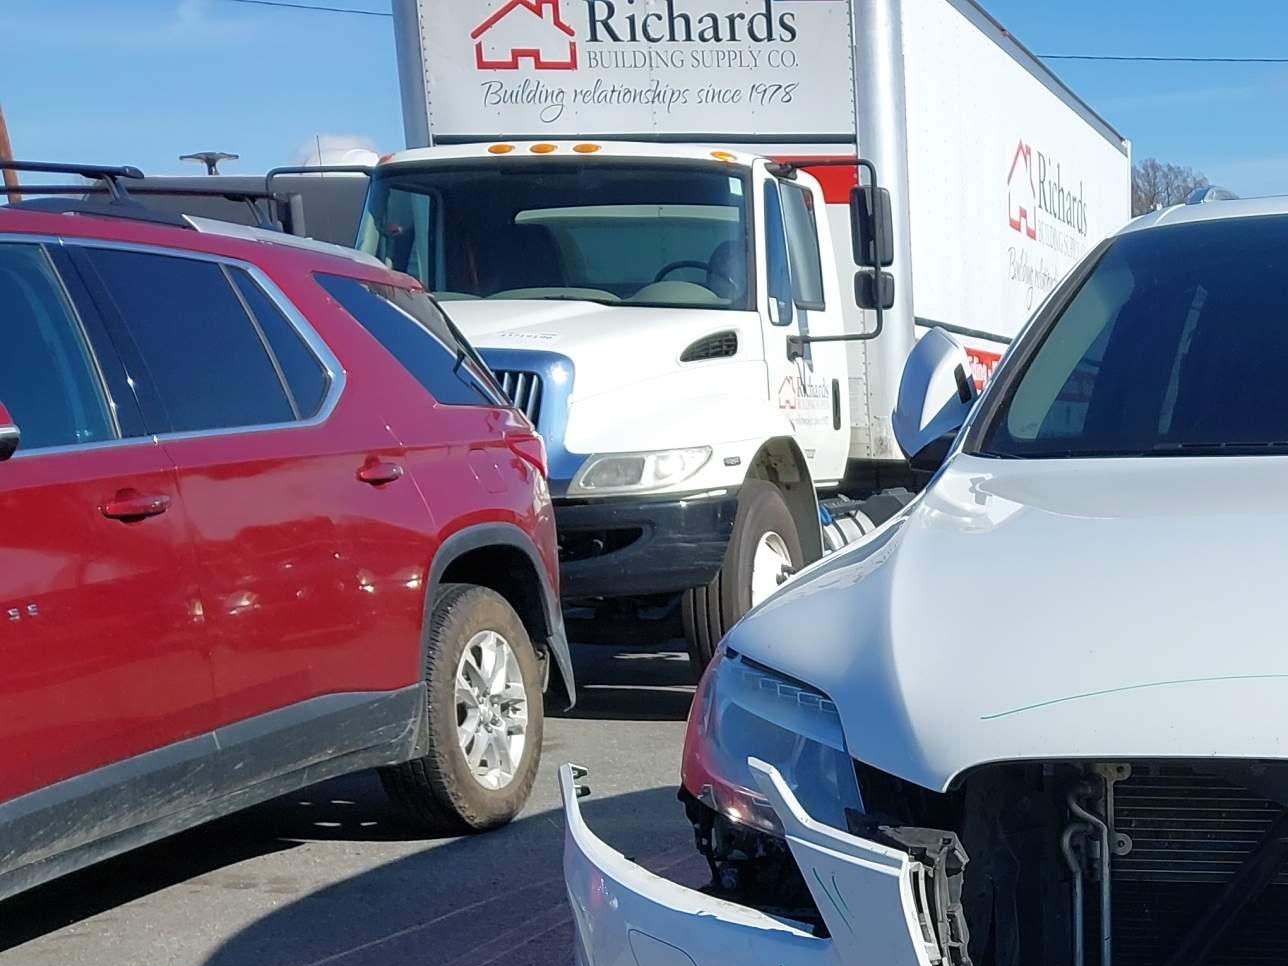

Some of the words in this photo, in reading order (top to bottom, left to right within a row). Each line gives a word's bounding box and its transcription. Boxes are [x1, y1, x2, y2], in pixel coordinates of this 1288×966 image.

[585, 0, 798, 44] Richards
[586, 50, 685, 69] BUILDING
[690, 49, 762, 70] SUPPLY
[767, 49, 799, 68] CO.
[481, 80, 566, 123] Building
[572, 80, 689, 113] relationships
[696, 84, 742, 105] since
[746, 82, 800, 105] 1978
[1037, 151, 1088, 237] Richards
